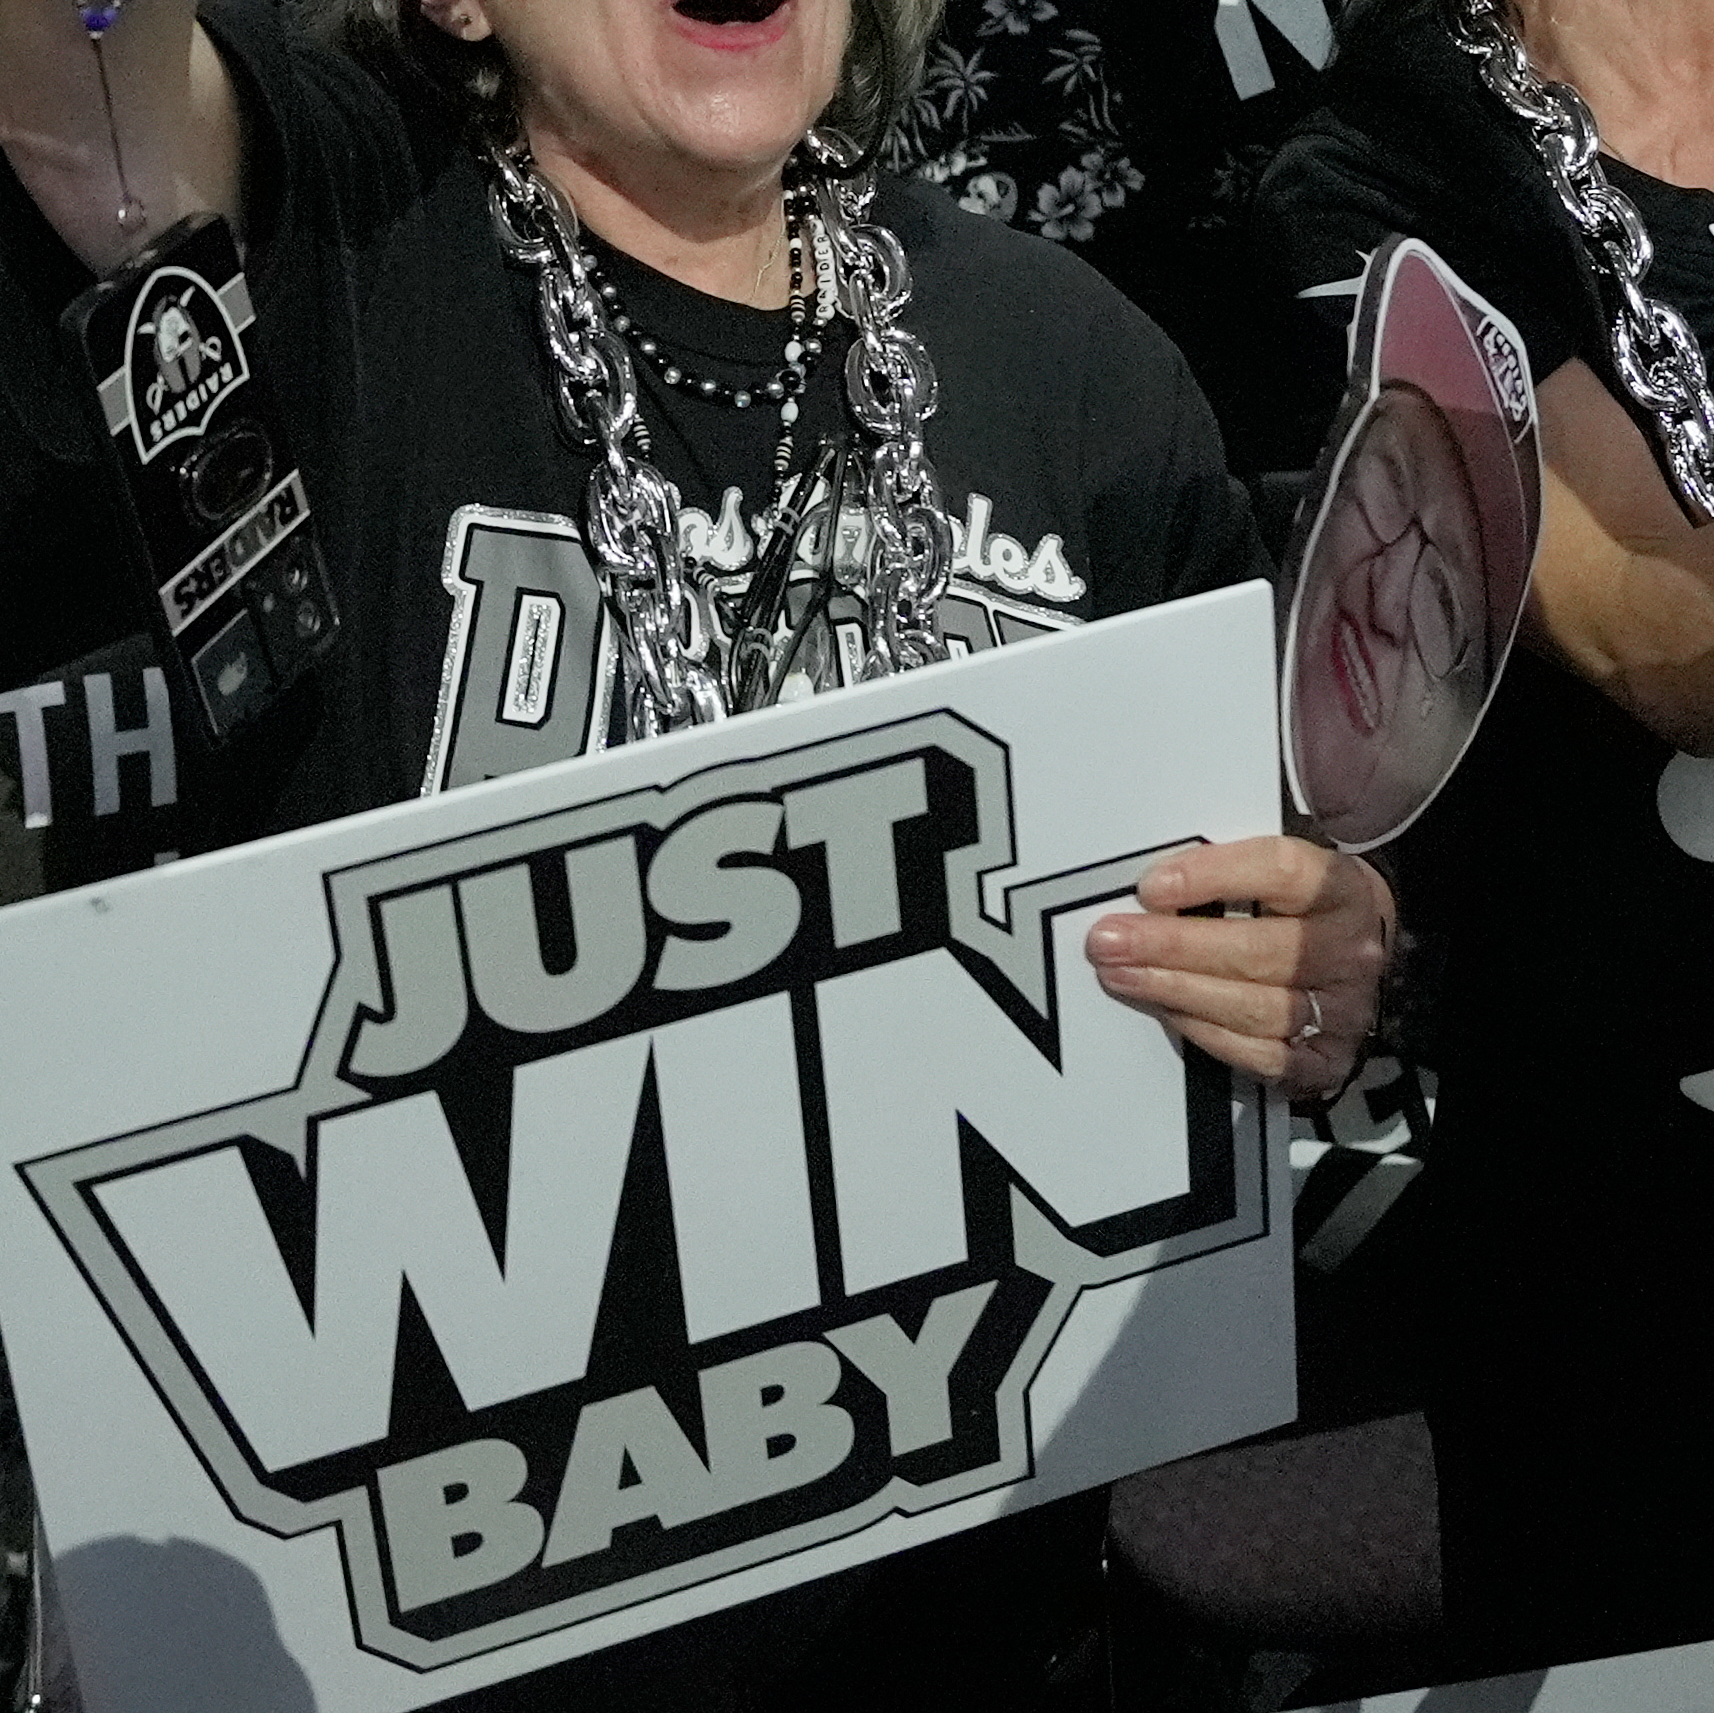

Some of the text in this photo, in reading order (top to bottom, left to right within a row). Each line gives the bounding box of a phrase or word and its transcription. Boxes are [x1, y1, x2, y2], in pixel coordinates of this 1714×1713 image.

[149, 362, 234, 443] RAIDERS
[173, 483, 303, 619] RAIDERS
[347, 756, 930, 1079] JUST
[90, 888, 1193, 1475] WIN
[376, 1279, 1001, 1615] BABY
